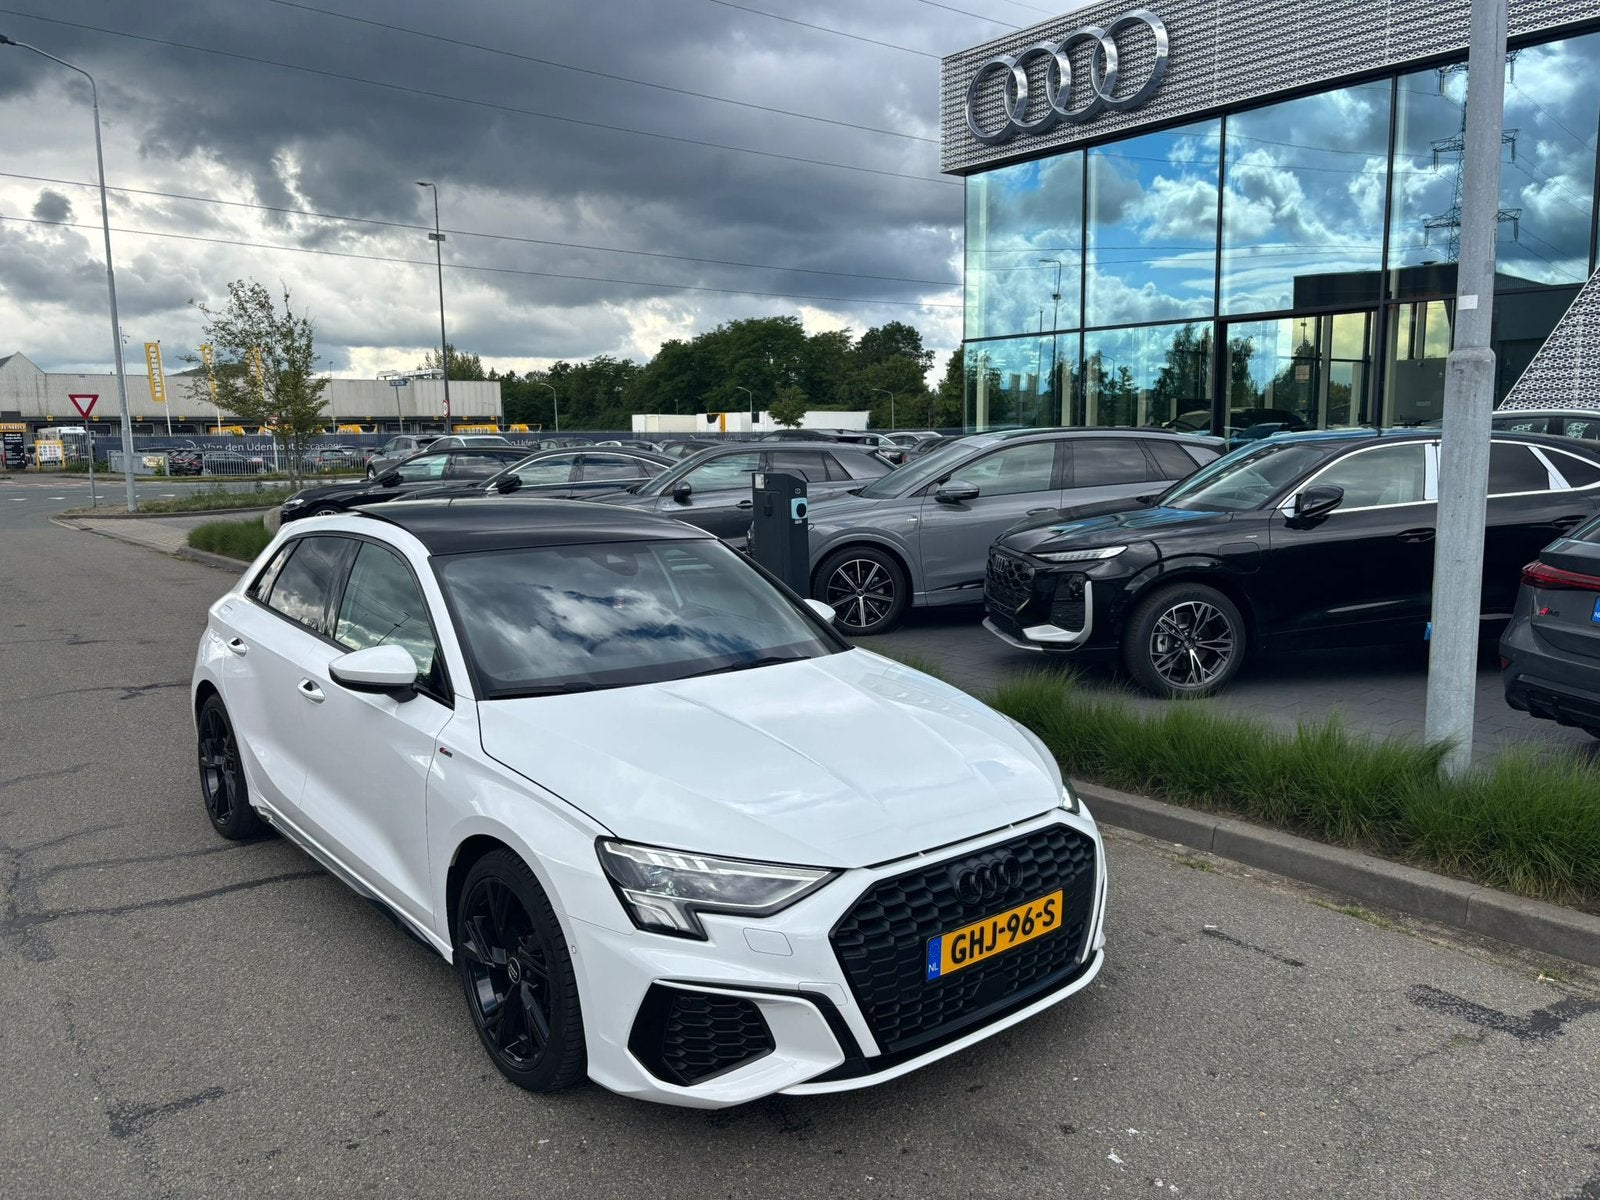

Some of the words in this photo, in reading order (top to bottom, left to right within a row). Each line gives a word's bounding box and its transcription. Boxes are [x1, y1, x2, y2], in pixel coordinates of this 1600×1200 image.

[225, 443, 244, 451] den
[928, 962, 939, 973] NL
[951, 898, 1055, 964] GHJ-96-S
